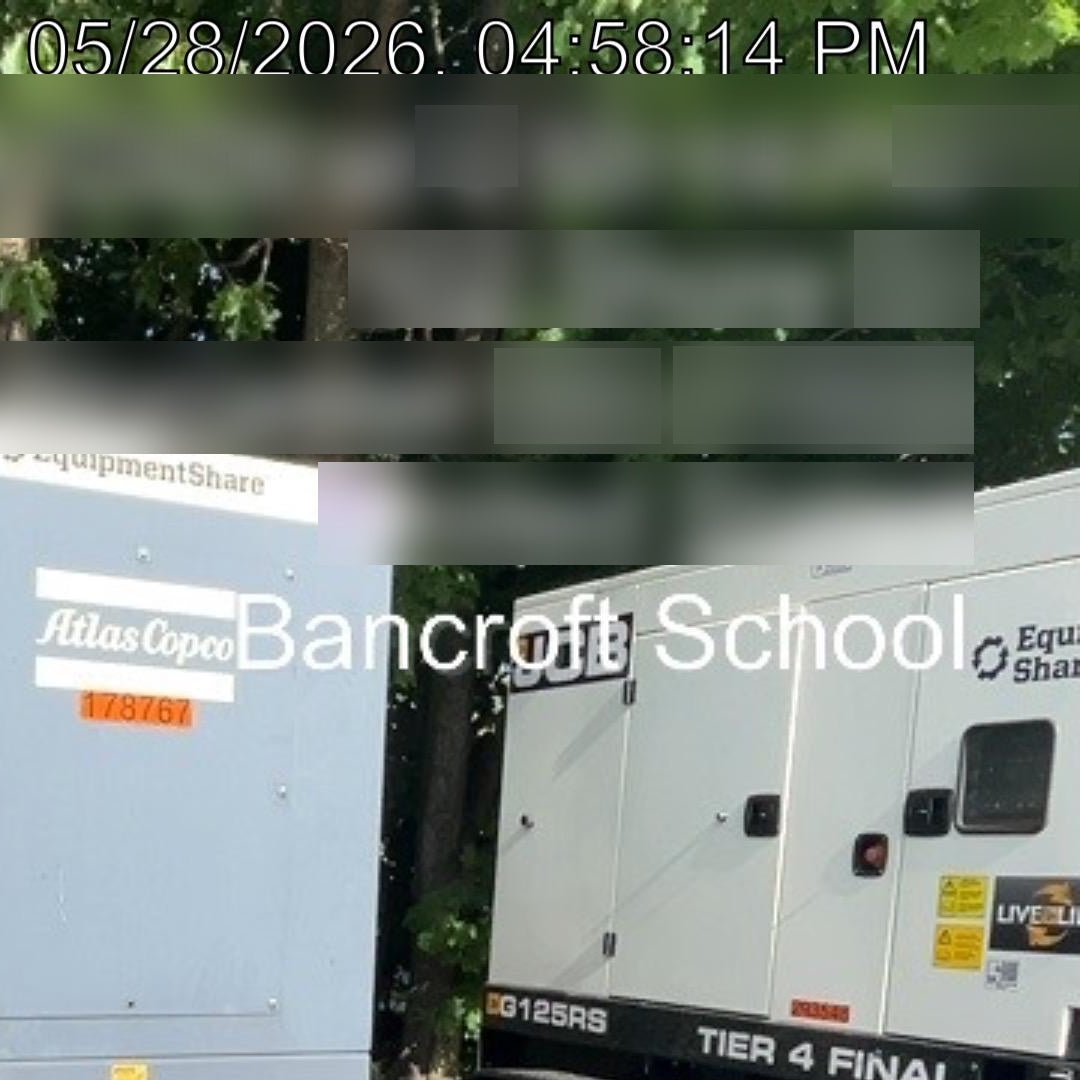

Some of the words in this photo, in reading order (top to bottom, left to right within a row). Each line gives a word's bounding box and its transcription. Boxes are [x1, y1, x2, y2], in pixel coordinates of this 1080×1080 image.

[35, 608, 140, 652] Atlas
[143, 617, 235, 666] Copco
[84, 691, 191, 724] 178767
[697, 1026, 775, 1066] TIER
[788, 1042, 815, 1072] 4
